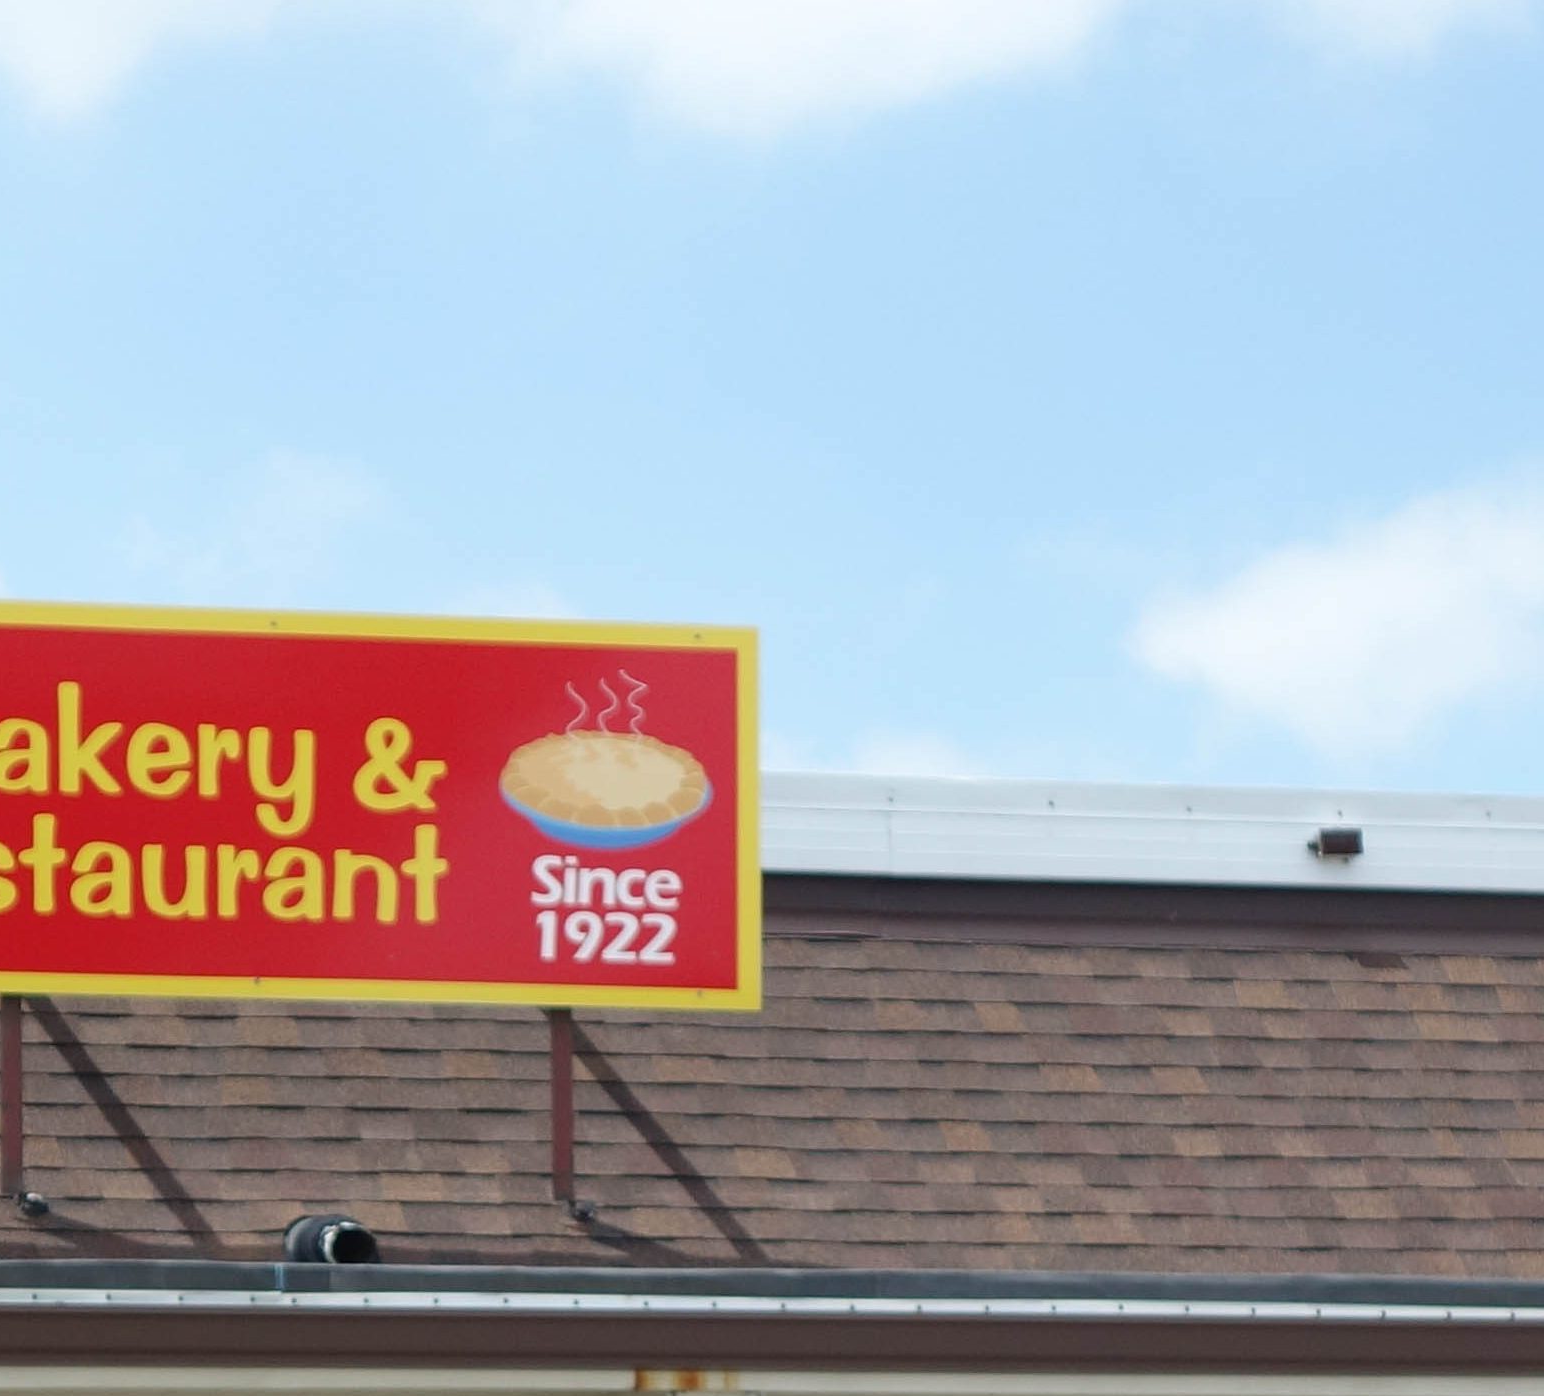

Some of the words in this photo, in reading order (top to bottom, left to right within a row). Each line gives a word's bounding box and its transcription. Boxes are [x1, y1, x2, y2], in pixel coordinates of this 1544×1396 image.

[353, 717, 447, 812] &
[531, 854, 683, 910] Since
[536, 908, 678, 965] 1922
